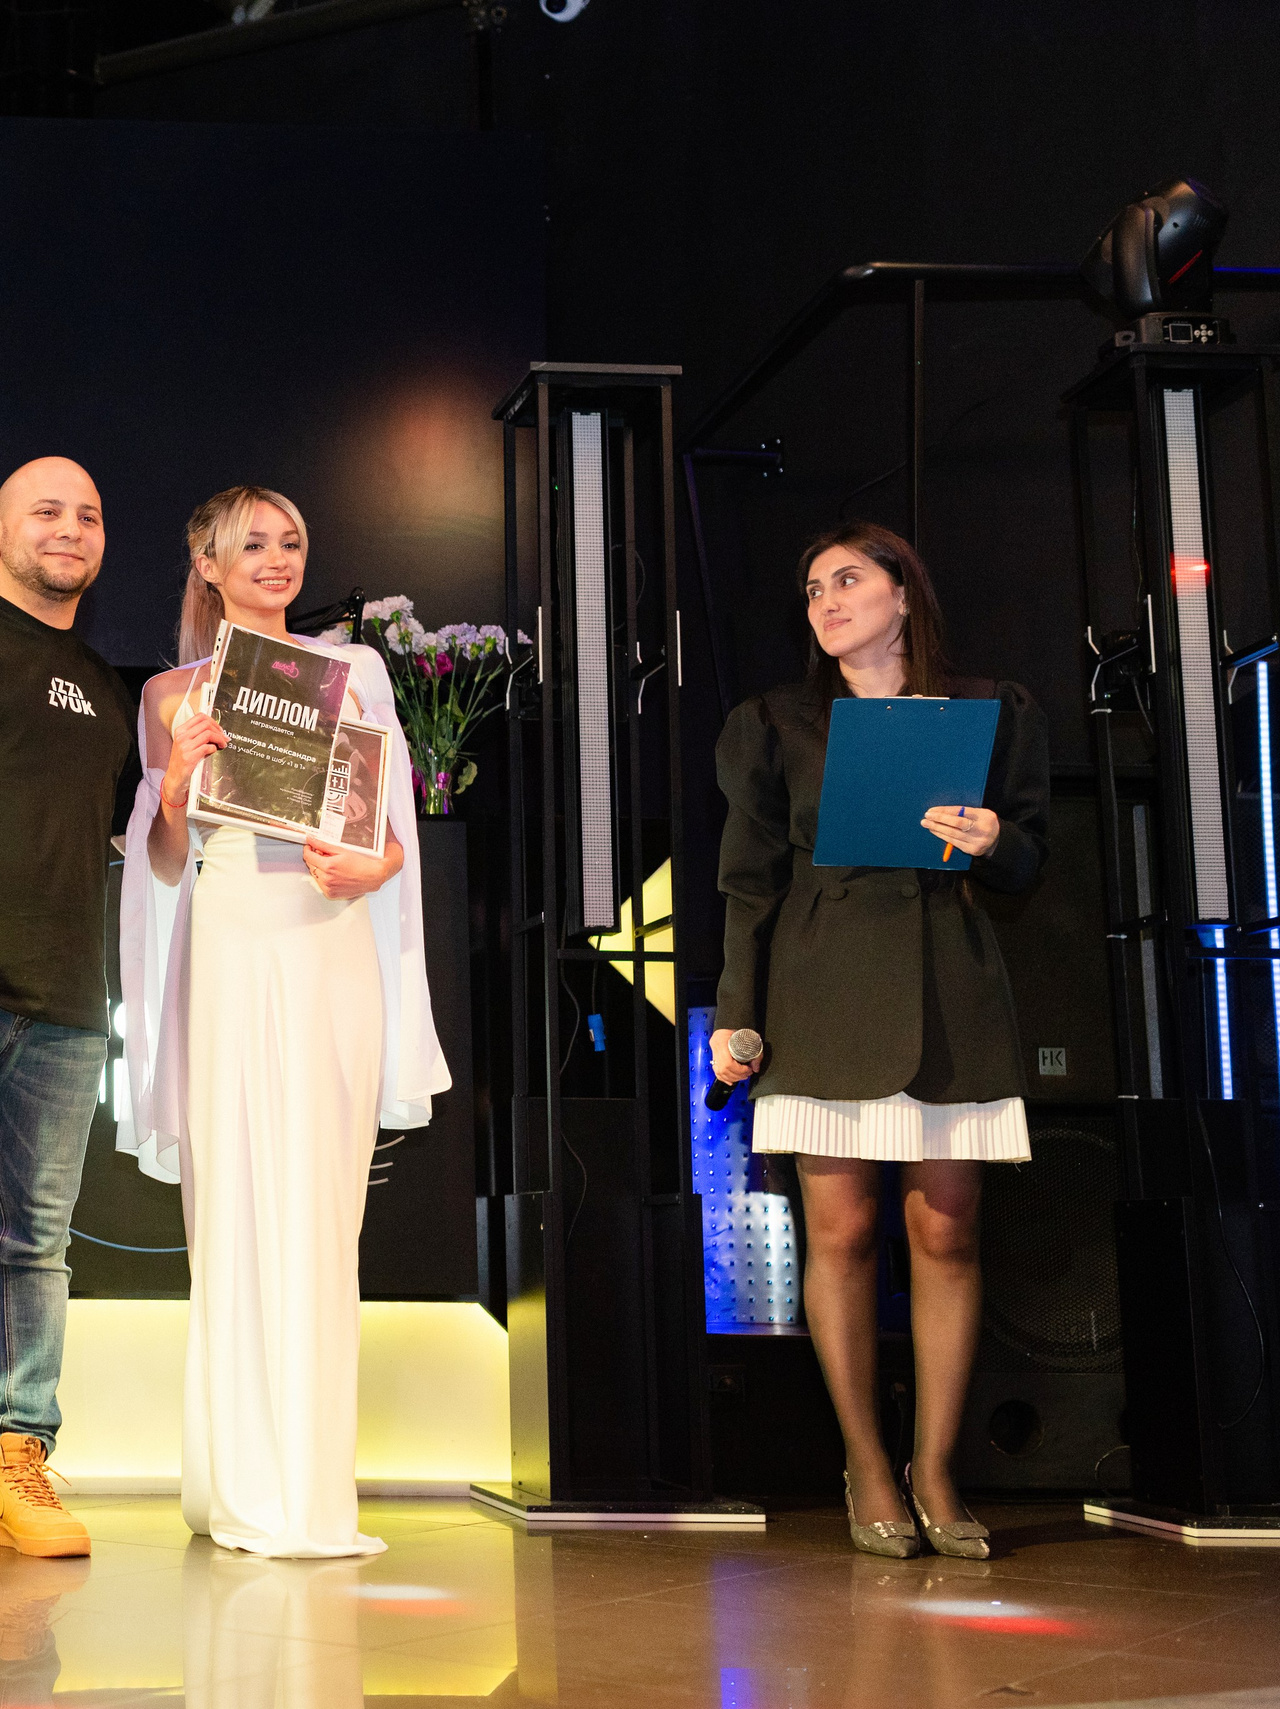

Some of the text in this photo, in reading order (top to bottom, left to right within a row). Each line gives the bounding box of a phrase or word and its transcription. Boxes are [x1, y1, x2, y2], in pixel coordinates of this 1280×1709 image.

[50, 676, 85, 700] IZZI
[48, 689, 97, 717] ZVUK
[232, 685, 320, 732] ДИПЛОМ
[250, 719, 295, 737] награждается
[228, 742, 237, 750] За
[237, 746, 266, 759] участие
[271, 756, 287, 766] шоу
[267, 743, 317, 763] Александра
[1042, 1050, 1063, 1067] HK
